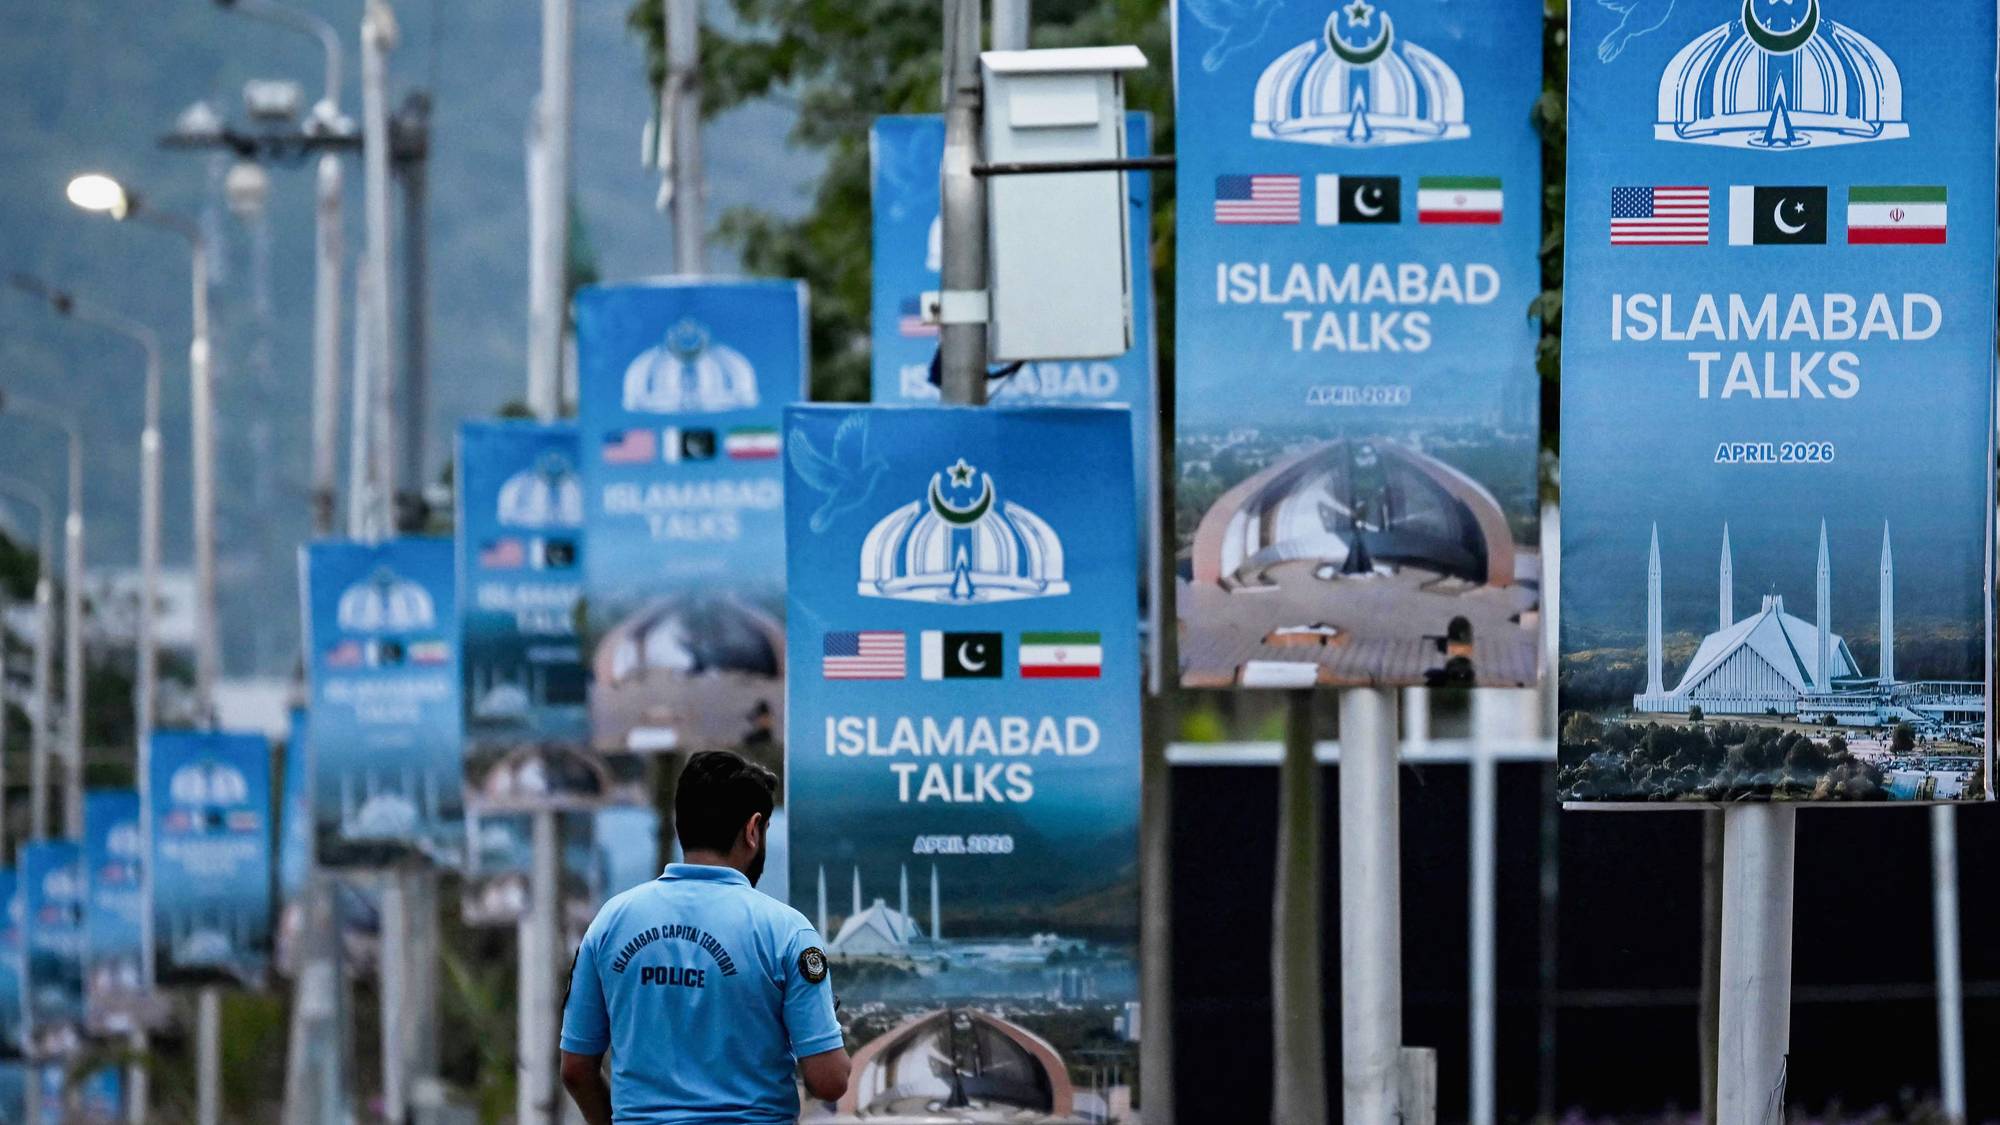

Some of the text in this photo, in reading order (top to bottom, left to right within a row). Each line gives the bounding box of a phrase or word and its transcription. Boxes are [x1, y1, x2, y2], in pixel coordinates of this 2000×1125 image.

[1216, 262, 1501, 304] ISLAMABAD
[1283, 310, 1432, 352] TALKS
[1611, 293, 1943, 341] ISLAMABAD
[900, 362, 1119, 399] ISABAD
[1688, 351, 1861, 399] TALKS
[1714, 442, 1835, 463] APRIL 2026
[826, 717, 1099, 755] ISLAMABAD
[890, 763, 1033, 802] TALKS
[912, 834, 1014, 854] APRIL 2026
[612, 924, 739, 977] ISLAMABAD CAPITAL TERRITORY
[641, 966, 705, 988] POLICE
